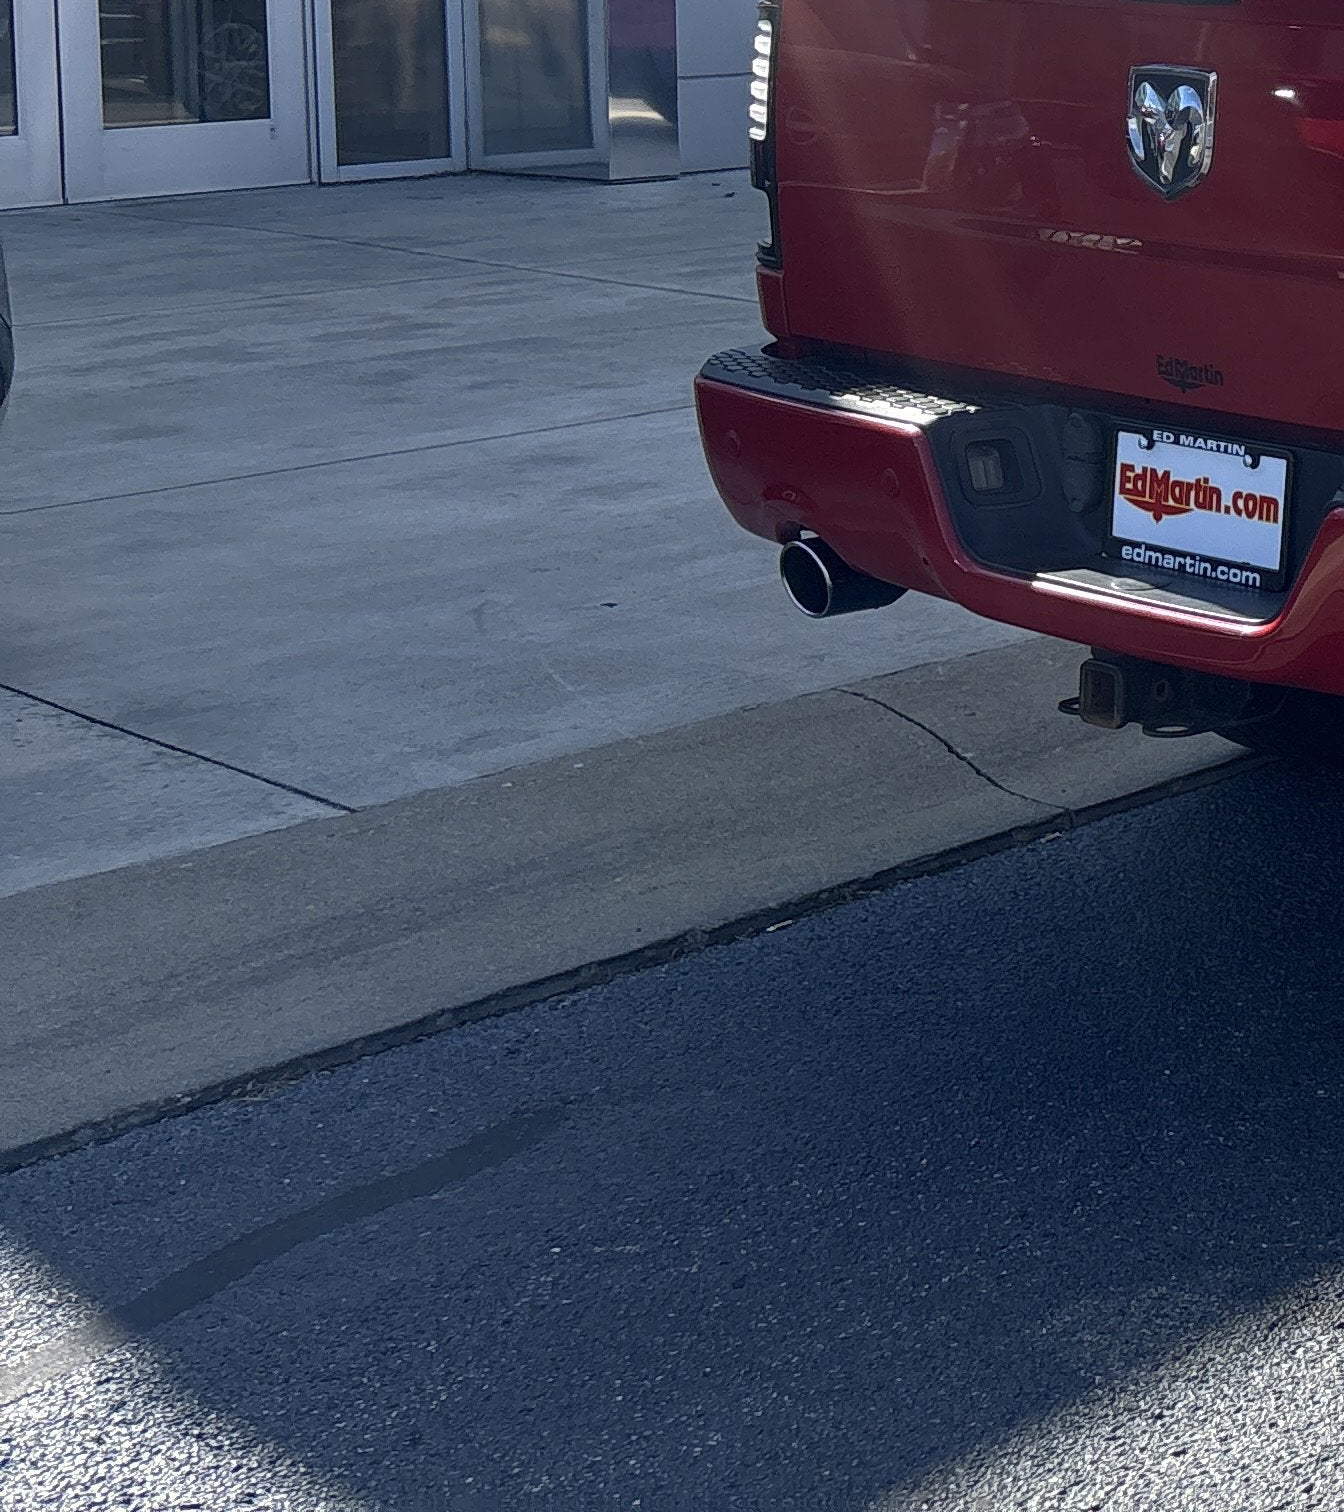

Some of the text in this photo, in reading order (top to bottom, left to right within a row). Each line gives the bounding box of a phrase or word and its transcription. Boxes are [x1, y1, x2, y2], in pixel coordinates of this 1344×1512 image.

[1155, 353, 1224, 387] EdMartin
[1152, 429, 1246, 456] ED MARTIN
[1117, 462, 1280, 524] EdMartin.com
[1121, 544, 1261, 587] edmartin.com
